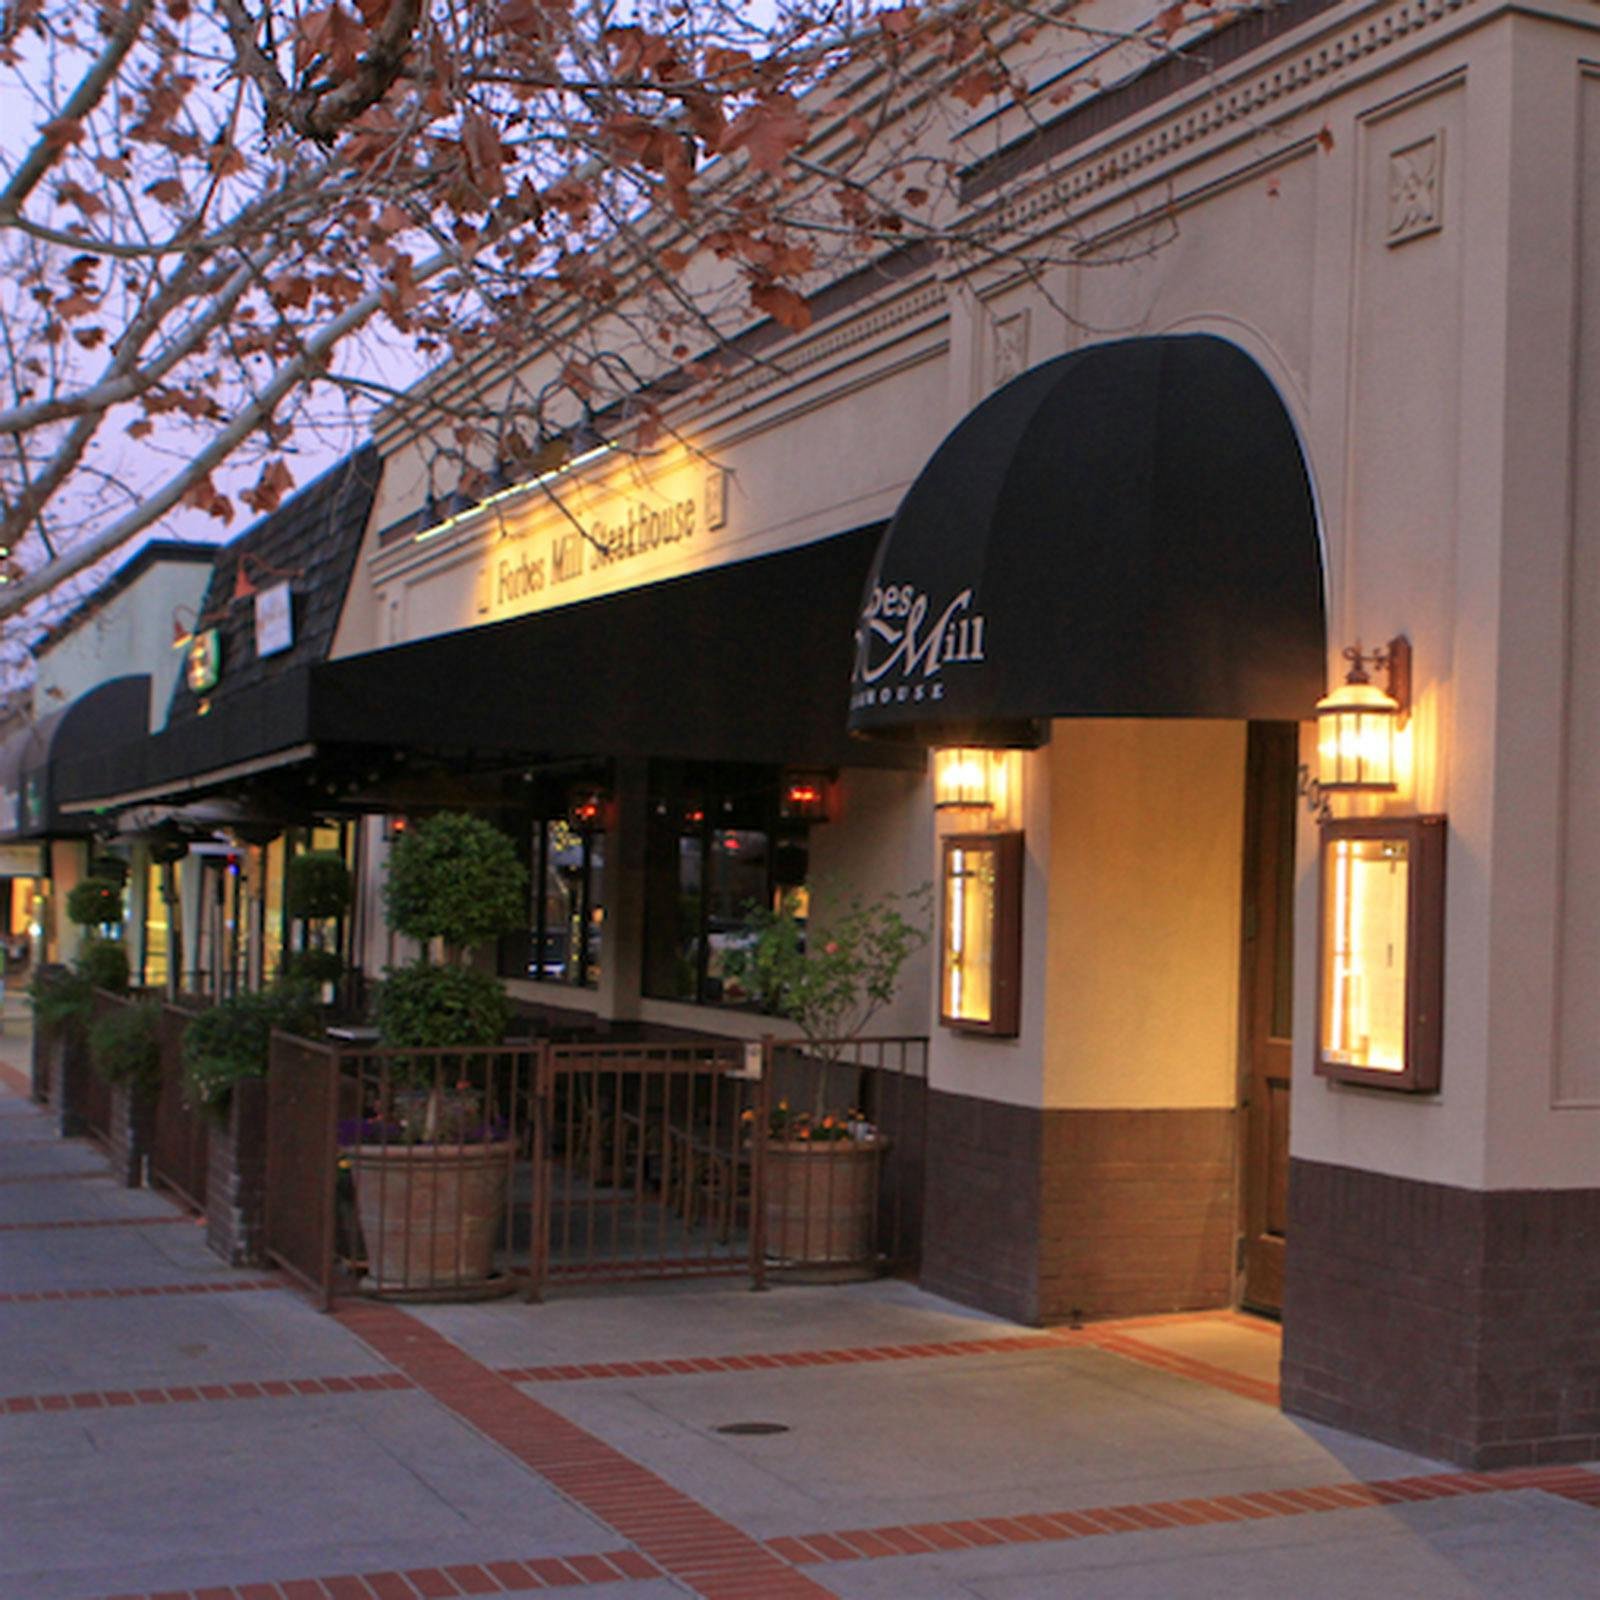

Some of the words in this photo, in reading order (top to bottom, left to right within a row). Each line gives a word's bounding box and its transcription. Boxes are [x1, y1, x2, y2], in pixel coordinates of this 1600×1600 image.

[497, 551, 546, 605] Forbes
[550, 534, 586, 585] Mill
[590, 498, 697, 571] Steakhouse
[860, 588, 985, 683] Mill
